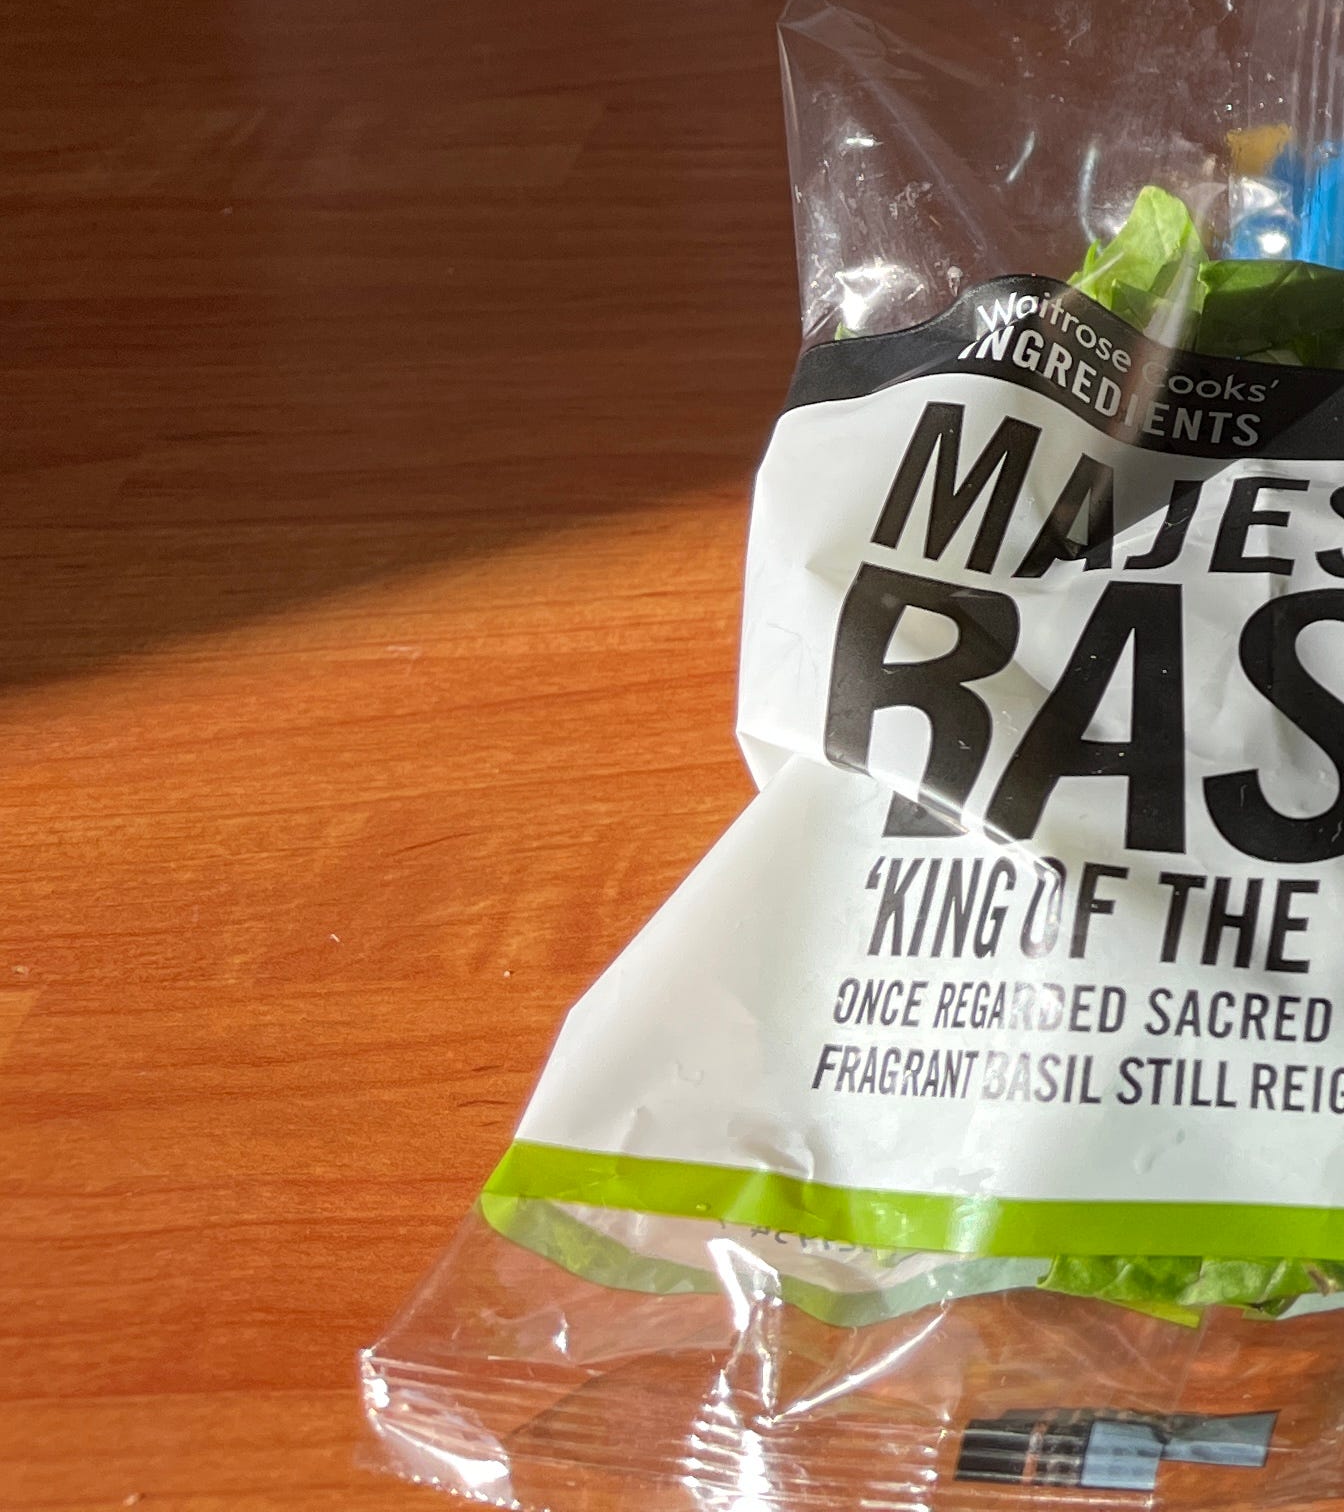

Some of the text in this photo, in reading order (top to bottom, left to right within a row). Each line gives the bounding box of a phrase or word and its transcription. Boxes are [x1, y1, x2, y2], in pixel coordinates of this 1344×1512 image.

[977, 292, 1132, 374] Waitrose
[958, 325, 1261, 447] INGREDIENTS
[1019, 856, 1130, 959] OF
[1158, 871, 1321, 974] THE
[832, 977, 928, 1029] ONCE
[932, 980, 1127, 1034] REGARDED
[1144, 987, 1333, 1044] SACRED
[811, 1043, 979, 1100] FRAGRANT
[981, 1049, 1102, 1105] BASIL
[1116, 1056, 1238, 1108] STILL
